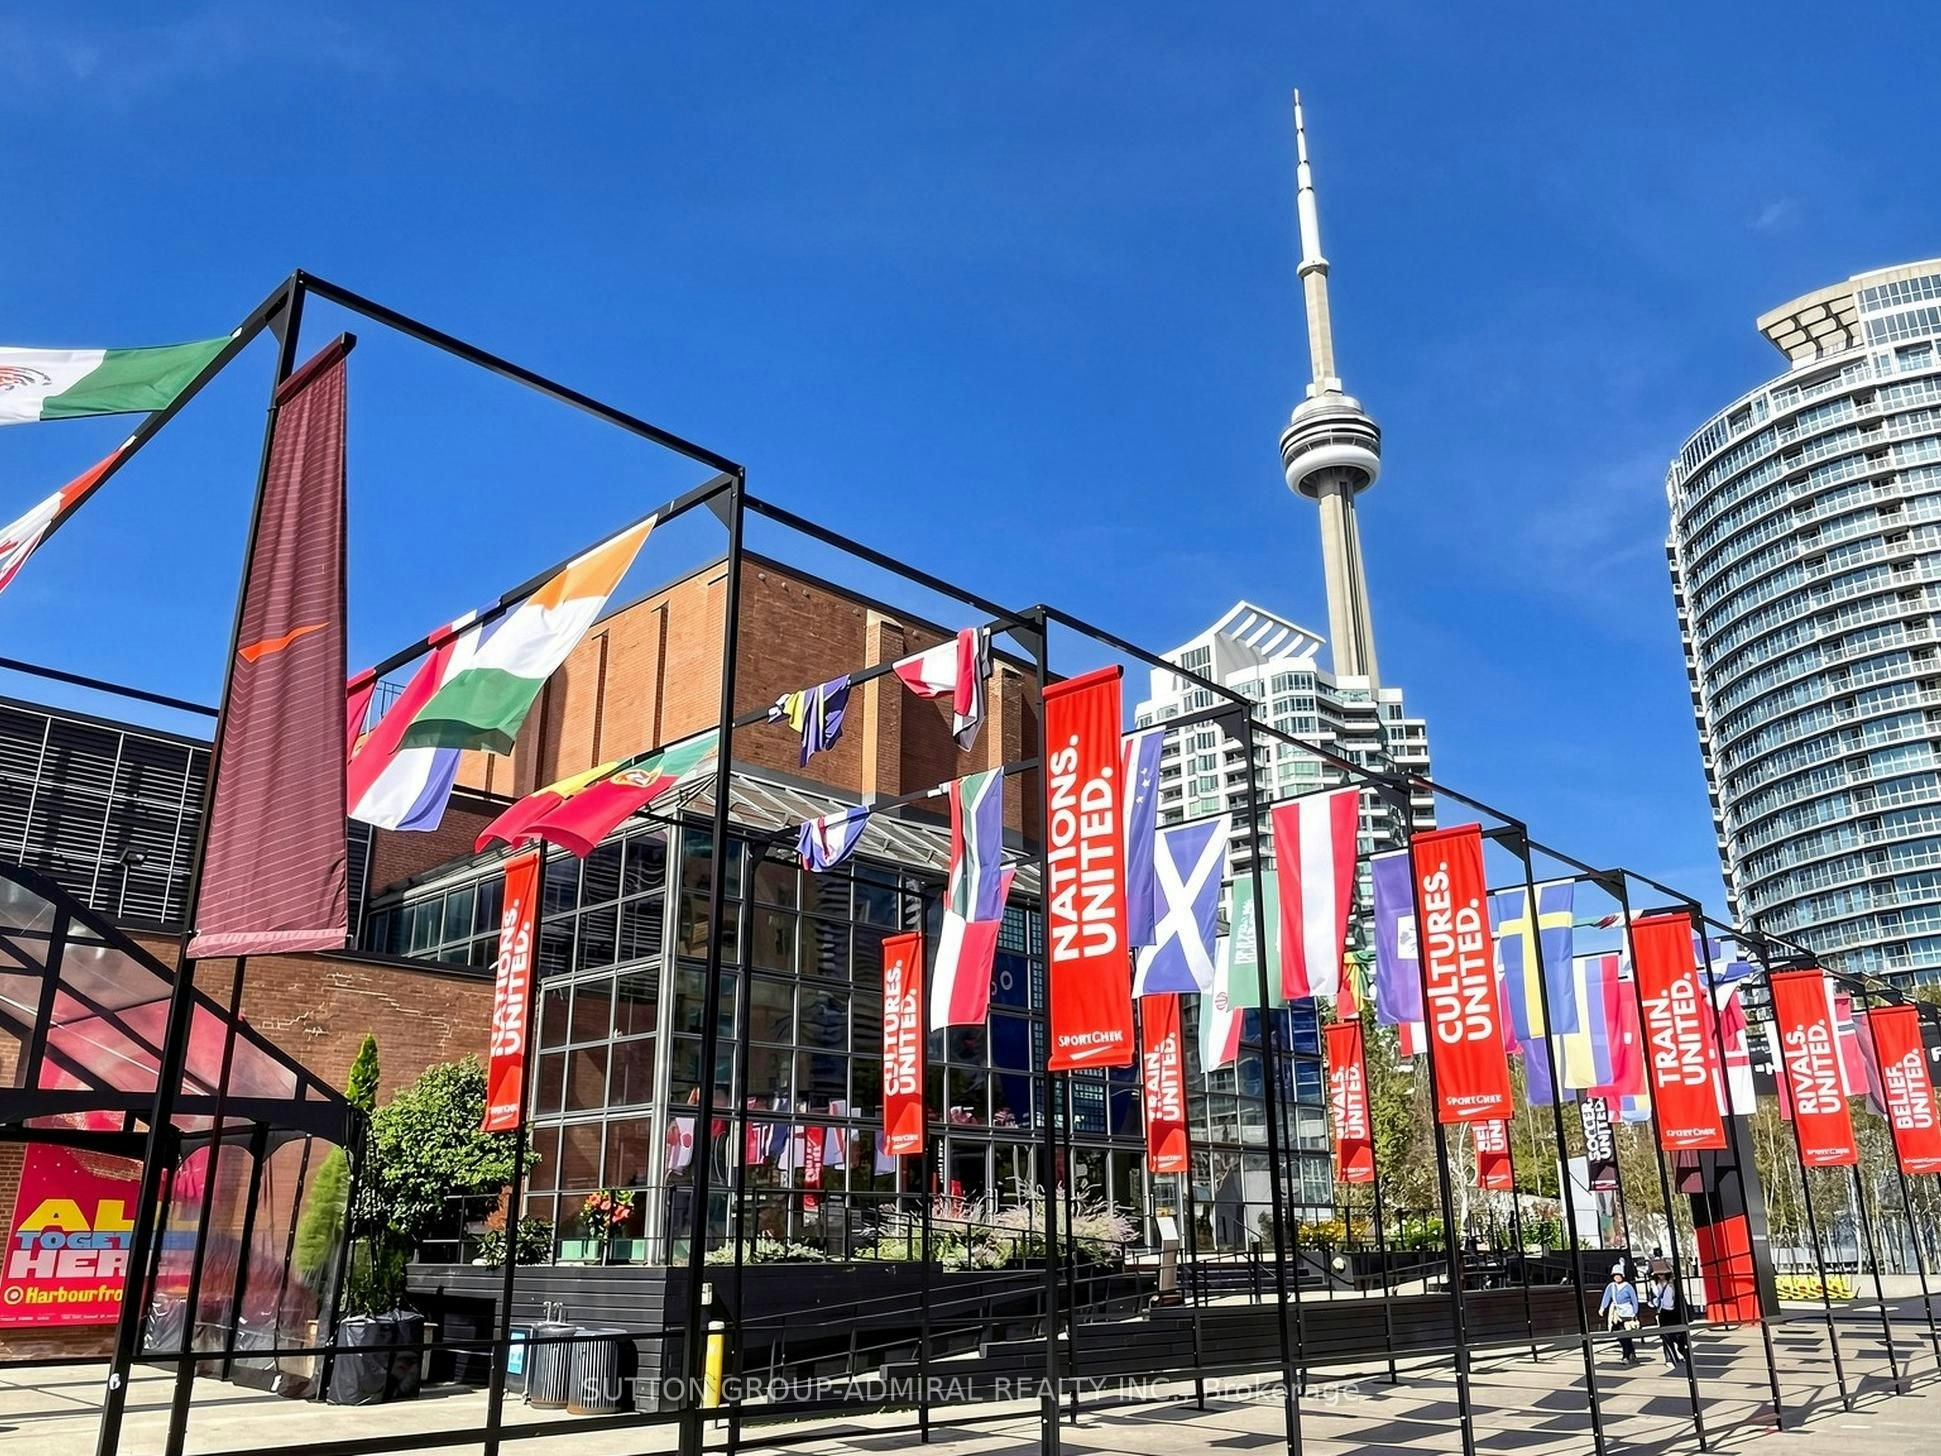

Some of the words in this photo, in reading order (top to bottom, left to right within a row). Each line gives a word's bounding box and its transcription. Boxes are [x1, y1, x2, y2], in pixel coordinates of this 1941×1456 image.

[1049, 734, 1079, 961] NATIONS.
[1081, 766, 1117, 958] UNITED.
[502, 921, 531, 1056] UNITED.
[1423, 861, 1464, 1044] CULTURES.
[1455, 897, 1492, 1041] UNITED.
[899, 988, 918, 1095] UNITED.
[1641, 988, 1681, 1087] TRAIN.
[1670, 971, 1707, 1085] UNITED.
[1784, 1024, 1817, 1115] RIVALS.
[1807, 1018, 1841, 1114] UNITED.
[1160, 1032, 1181, 1121] UNITED.
[1346, 1062, 1366, 1139] UNITED.
[1885, 1061, 1915, 1129] BELIEF.
[1903, 1048, 1933, 1128] UNITED.
[8, 1249, 130, 1279] HER
[15, 1231, 133, 1249] TOGET
[25, 1284, 124, 1304] Harbourfro
